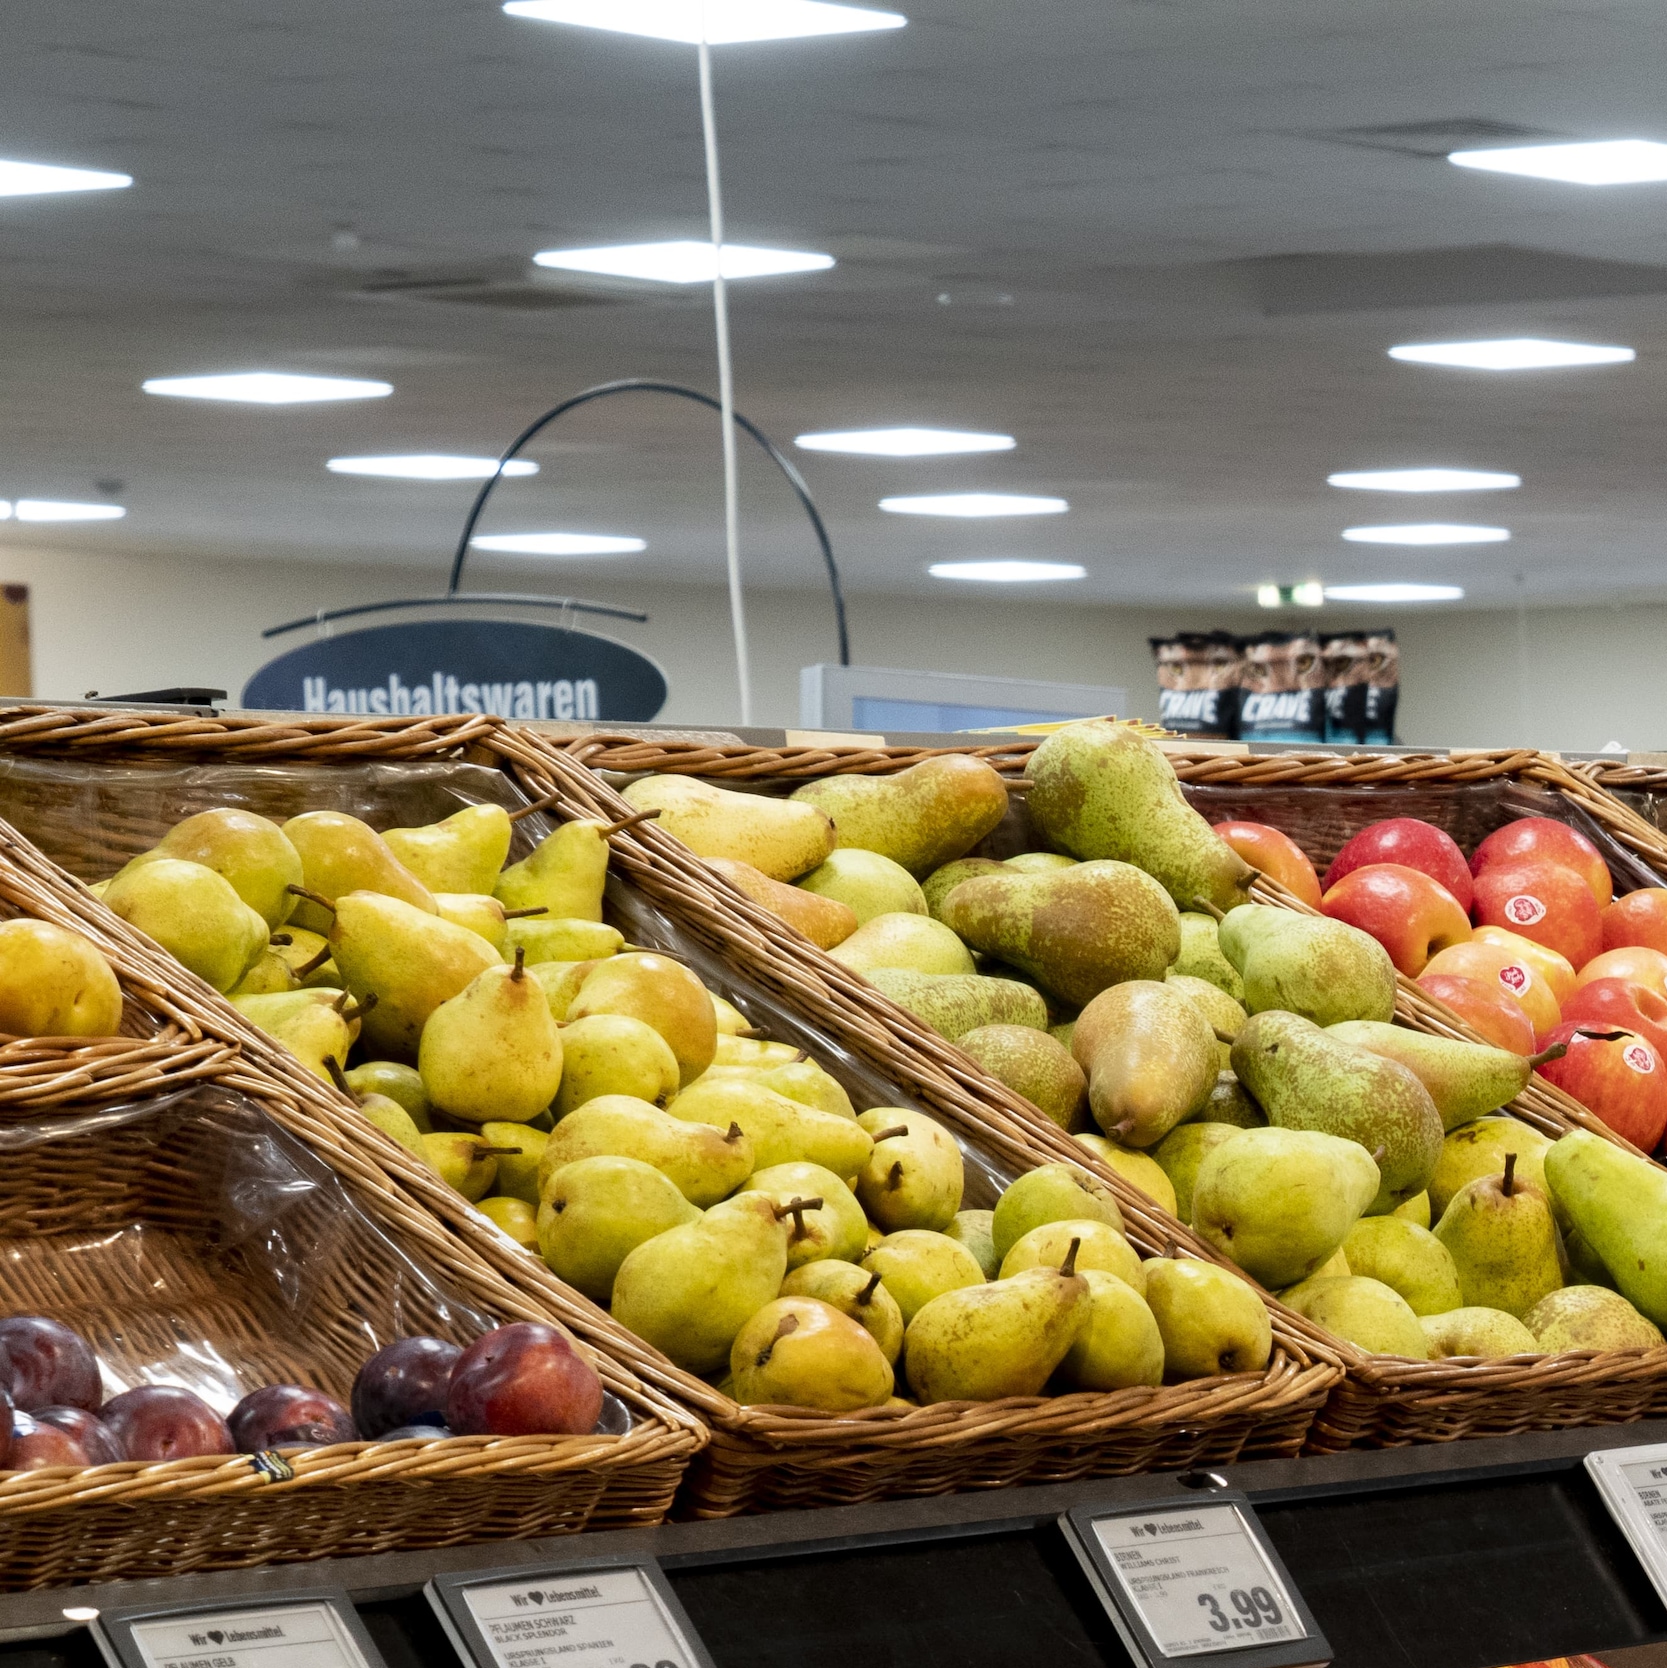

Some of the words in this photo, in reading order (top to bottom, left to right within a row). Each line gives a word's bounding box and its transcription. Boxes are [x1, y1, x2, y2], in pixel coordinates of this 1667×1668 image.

[302, 670, 598, 720] Haushaltswaren
[1241, 687, 1313, 722] CRAVE
[1129, 1526, 1145, 1538] Wir
[1120, 1560, 1156, 1571] WILLIAMS
[1156, 1555, 1181, 1566] CHRIST
[1186, 1566, 1230, 1579] FRANKREICH
[510, 1593, 530, 1608] Wir
[1197, 1585, 1284, 1633] 3.99
[489, 1619, 534, 1636] PFLAUMEN
[535, 1615, 578, 1628] SCHWARZ
[188, 1633, 208, 1647] Wir
[495, 1632, 522, 1644] BLACK
[524, 1627, 569, 1640] SPLENDOR
[504, 1644, 576, 1660] URSPRUNGSLAND
[576, 1639, 615, 1651] SPANIEN
[212, 1656, 237, 1668] GELB
